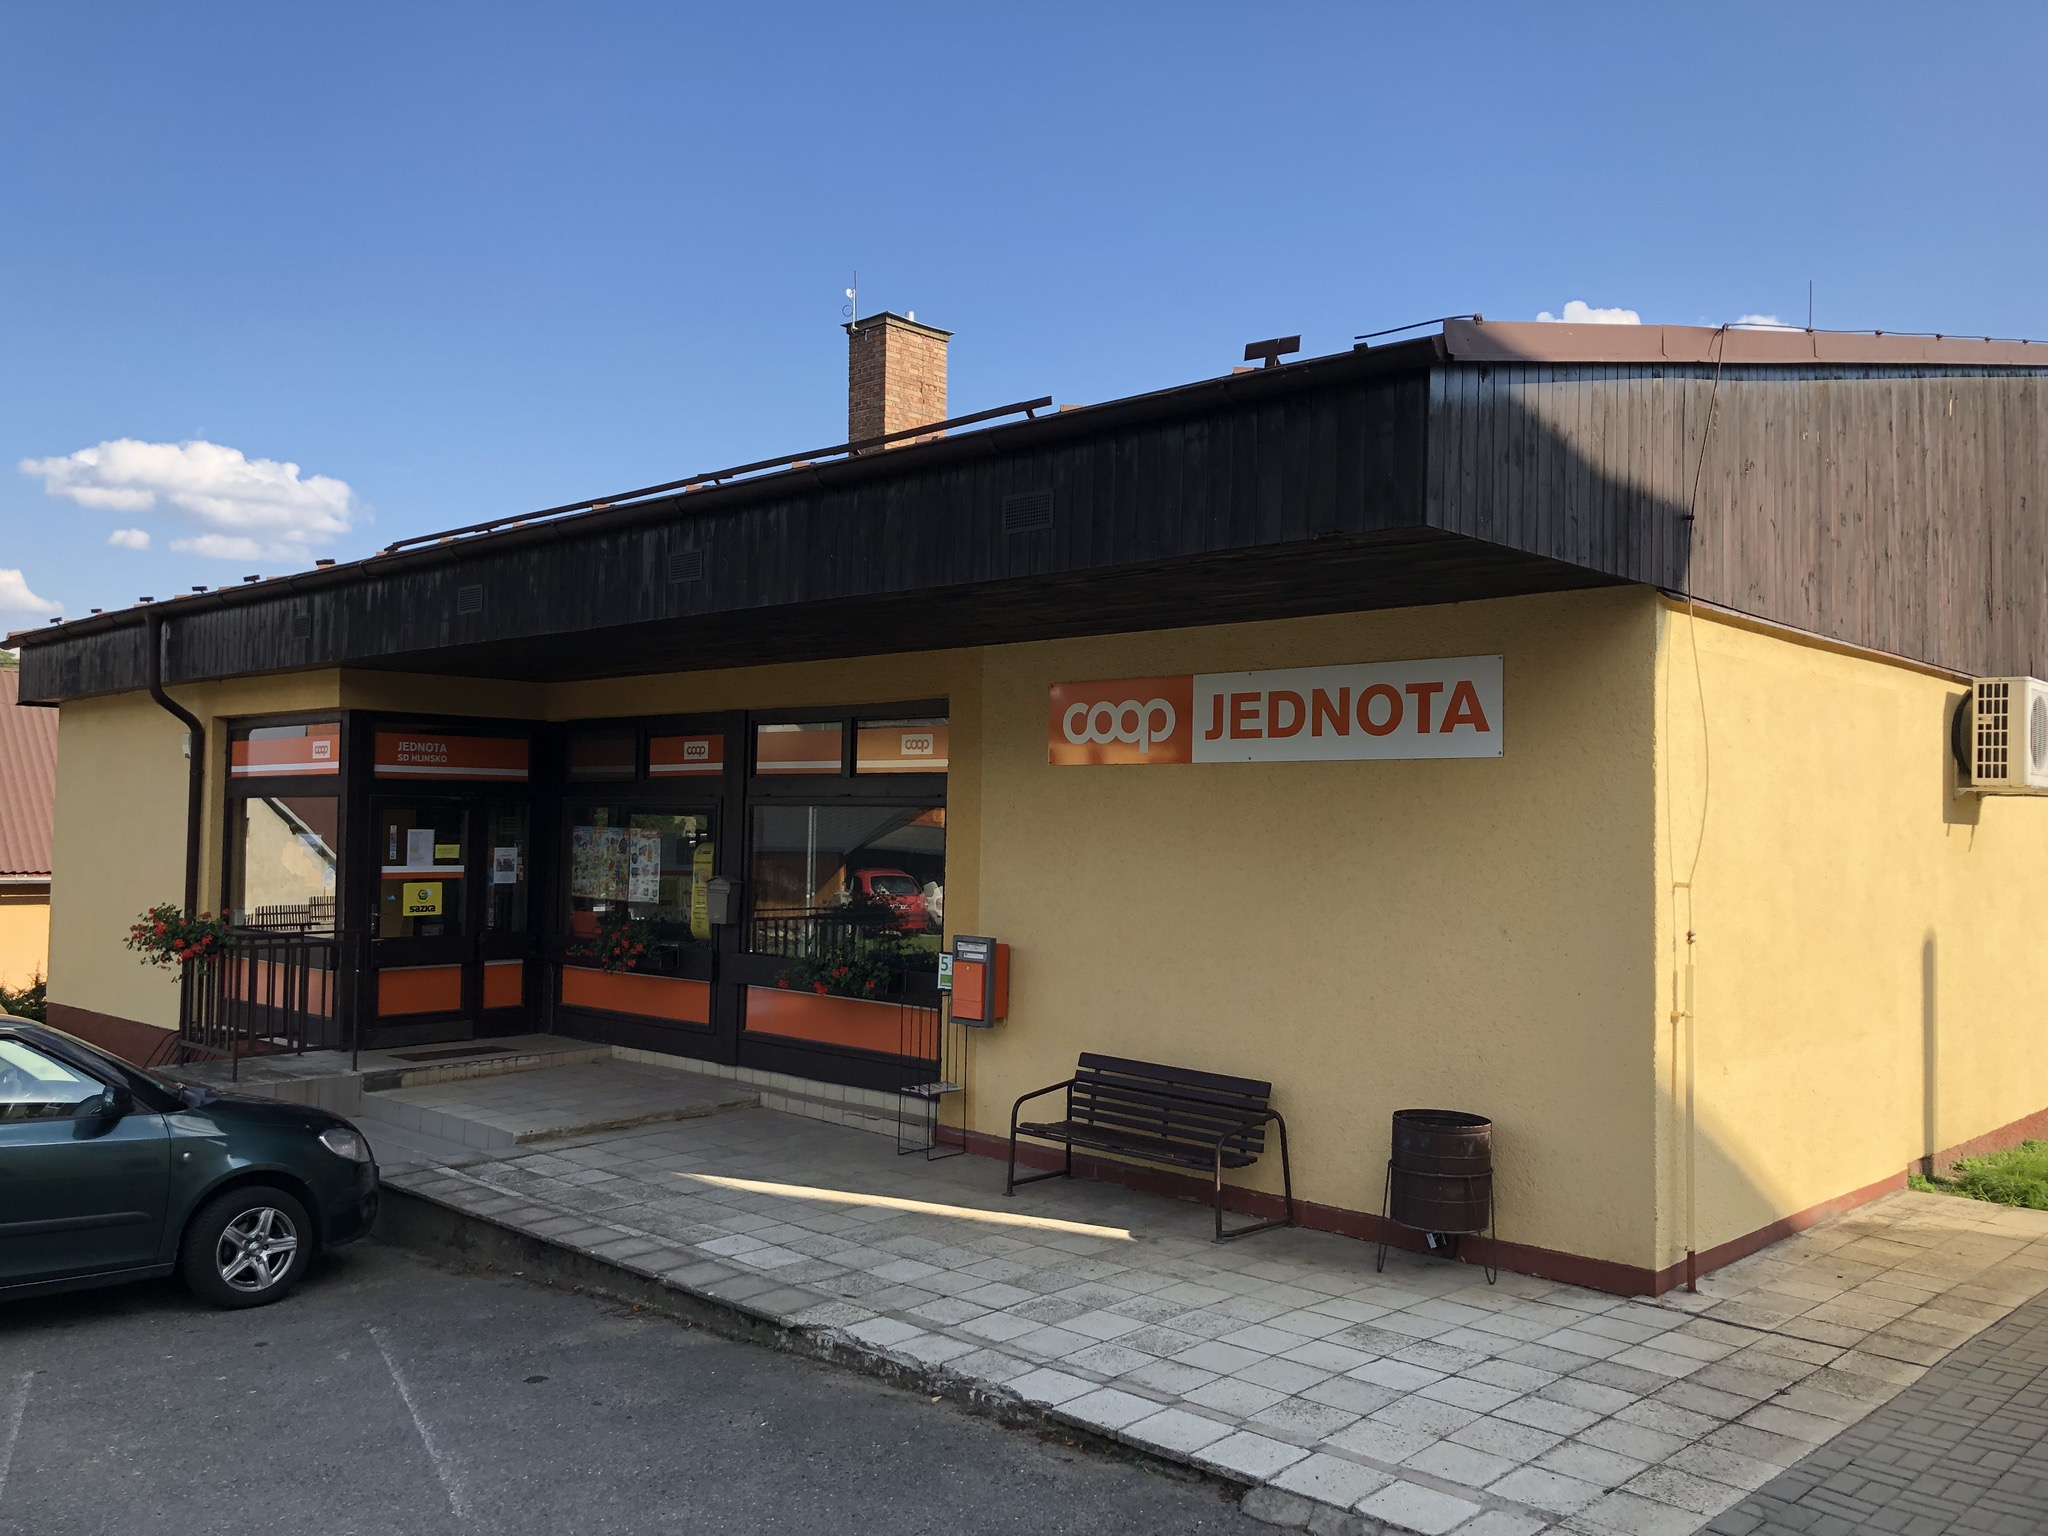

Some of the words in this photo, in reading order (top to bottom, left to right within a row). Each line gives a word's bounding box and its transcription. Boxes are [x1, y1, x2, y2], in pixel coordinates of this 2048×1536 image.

[1062, 697, 1176, 754] coop
[1204, 680, 1491, 740] JEDNOTA
[397, 741, 448, 753] JEDNOTA
[687, 745, 706, 757] coop
[905, 739, 930, 752] coop
[397, 753, 410, 762] SD
[411, 754, 448, 763] HLINSKO
[940, 956, 949, 971] 5
